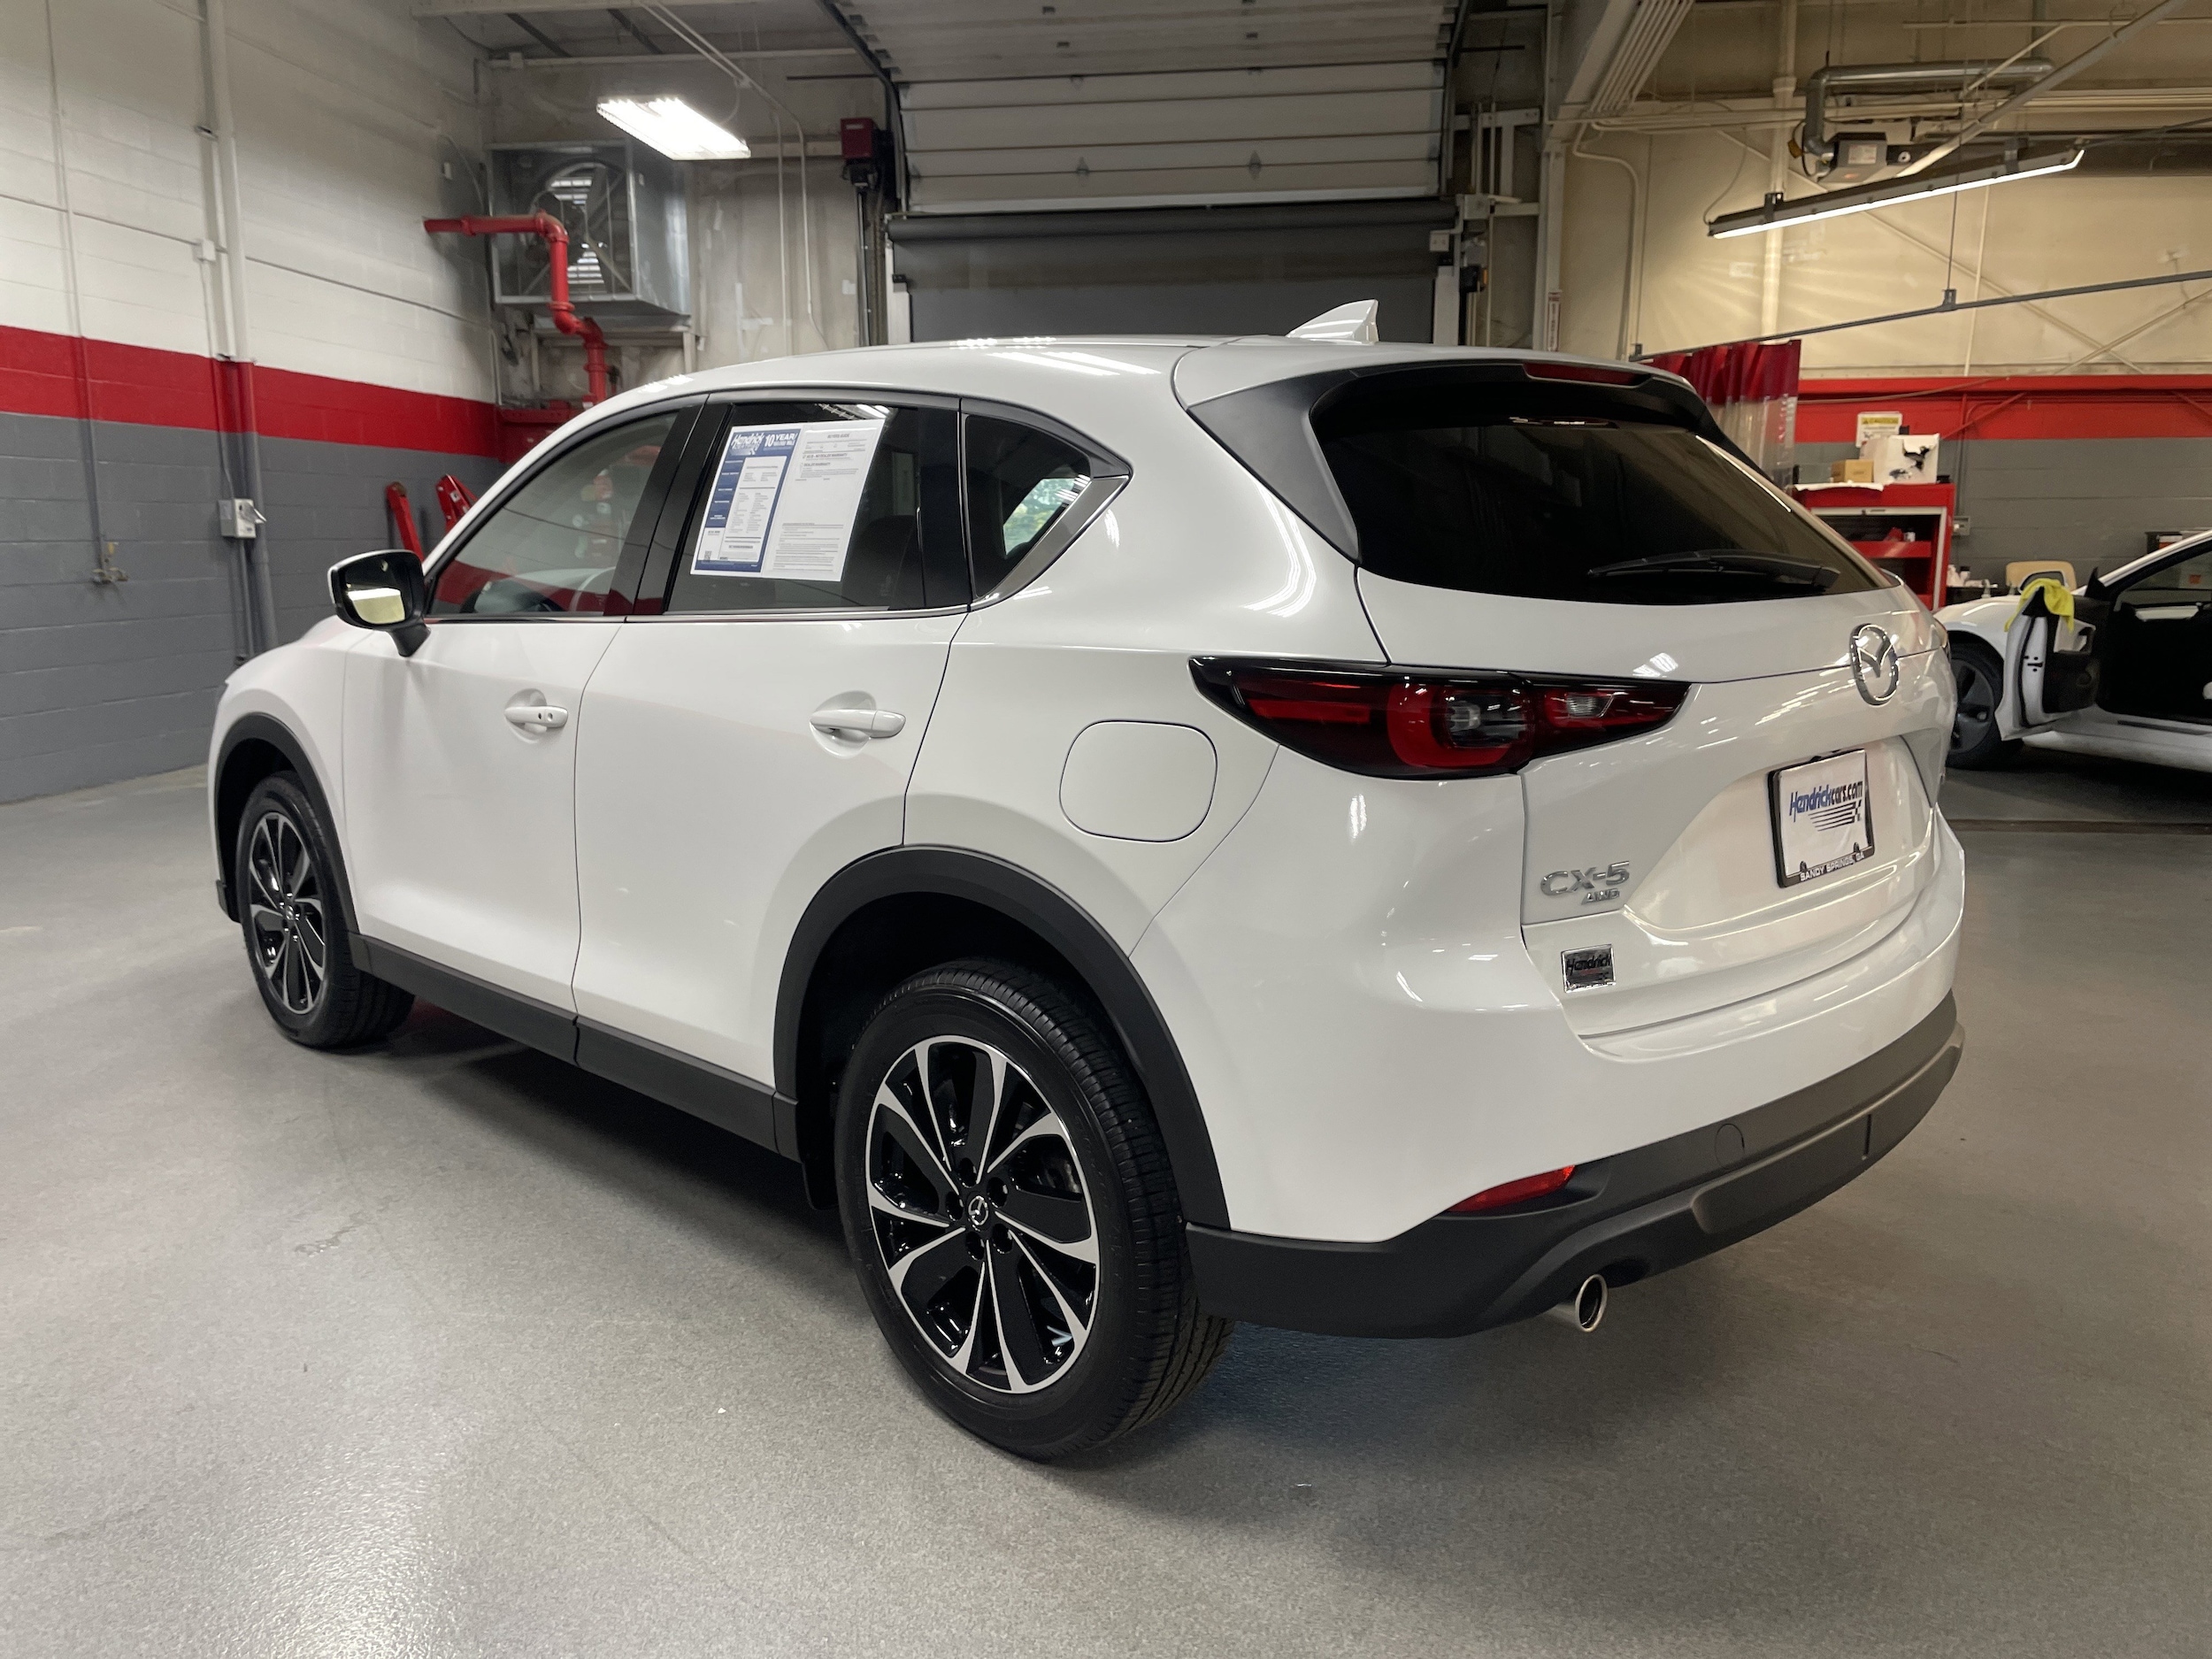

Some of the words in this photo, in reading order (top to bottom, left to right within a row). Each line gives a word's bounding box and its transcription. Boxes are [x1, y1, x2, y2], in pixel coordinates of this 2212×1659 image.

[764, 434, 775, 447] 10
[1789, 781, 1863, 823] Hendrickcars.com
[1540, 861, 1630, 895] CX-5
[1800, 867, 1825, 882] SANDY
[1826, 856, 1855, 871] SPRINGS,
[1581, 887, 1620, 905] AWD
